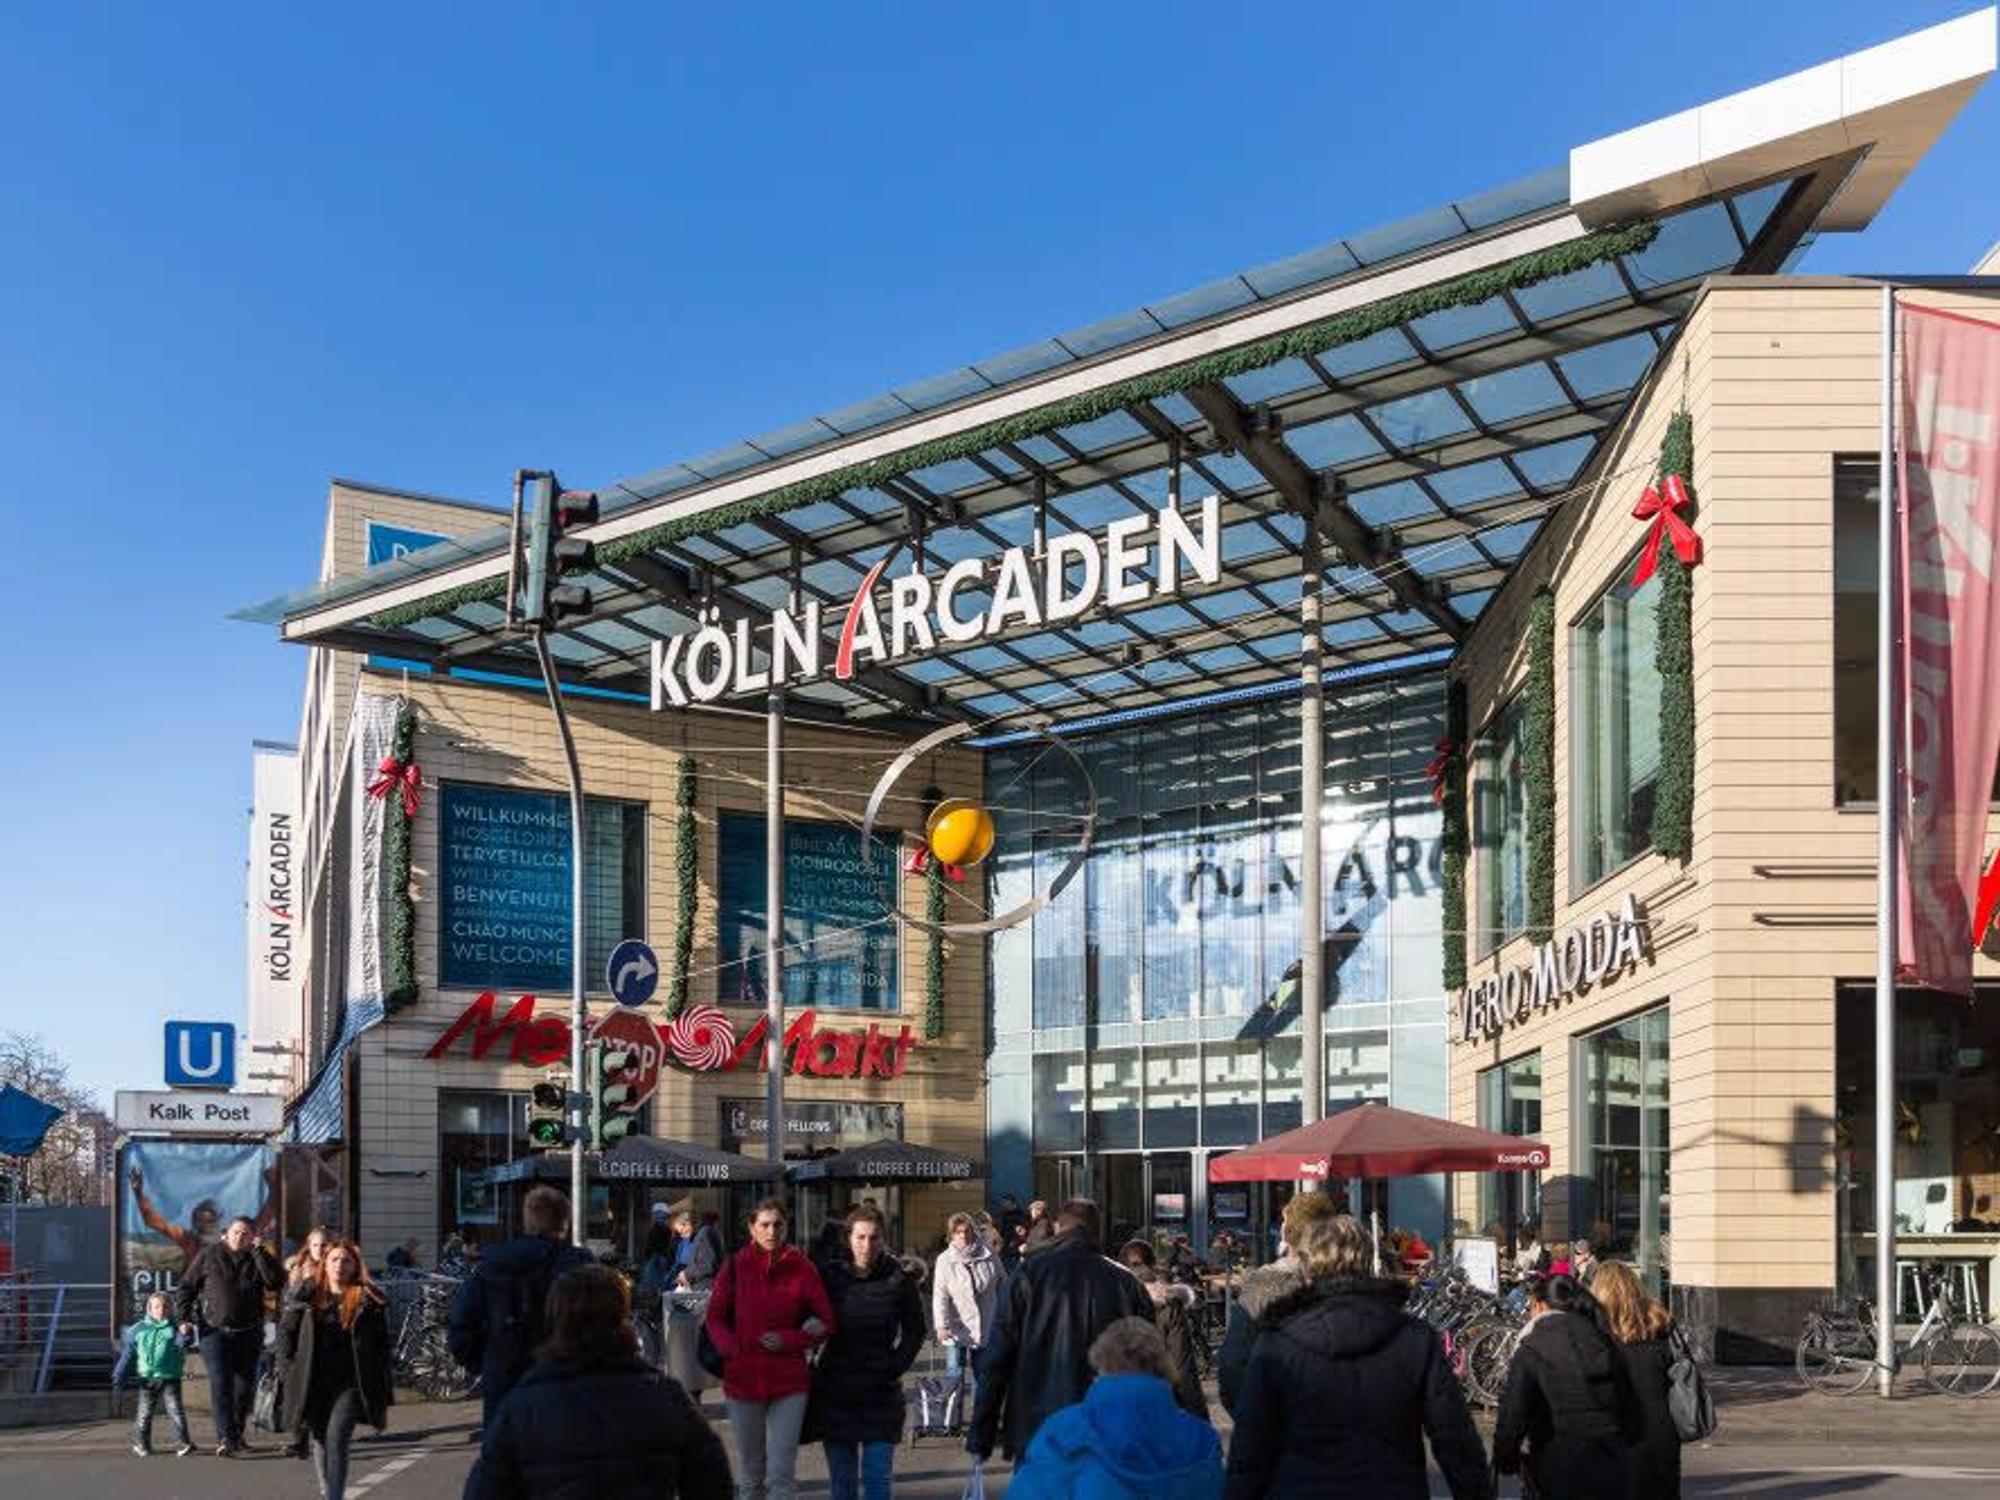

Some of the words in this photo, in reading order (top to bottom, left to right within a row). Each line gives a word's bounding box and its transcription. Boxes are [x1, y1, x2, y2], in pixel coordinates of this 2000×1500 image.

[650, 600, 820, 711] KÖLN
[835, 496, 1222, 680] ARCADEN
[265, 813, 293, 920] ARCADEN
[451, 845, 568, 867] TERVETULOA
[453, 885, 568, 908] BENVENUTI
[264, 922, 292, 981] KÖLN
[453, 943, 568, 966] WELCOME
[1459, 965, 1524, 1041] VERO
[1530, 893, 1643, 1009] MODA
[180, 1030, 222, 1078] U
[151, 1104, 193, 1121] Kalk
[205, 1105, 250, 1121] Post
[610, 1161, 663, 1178] COFFEE
[666, 1163, 729, 1179] FELLOWS
[867, 1160, 913, 1174] COFFEE
[916, 1160, 970, 1176] FELLOWS
